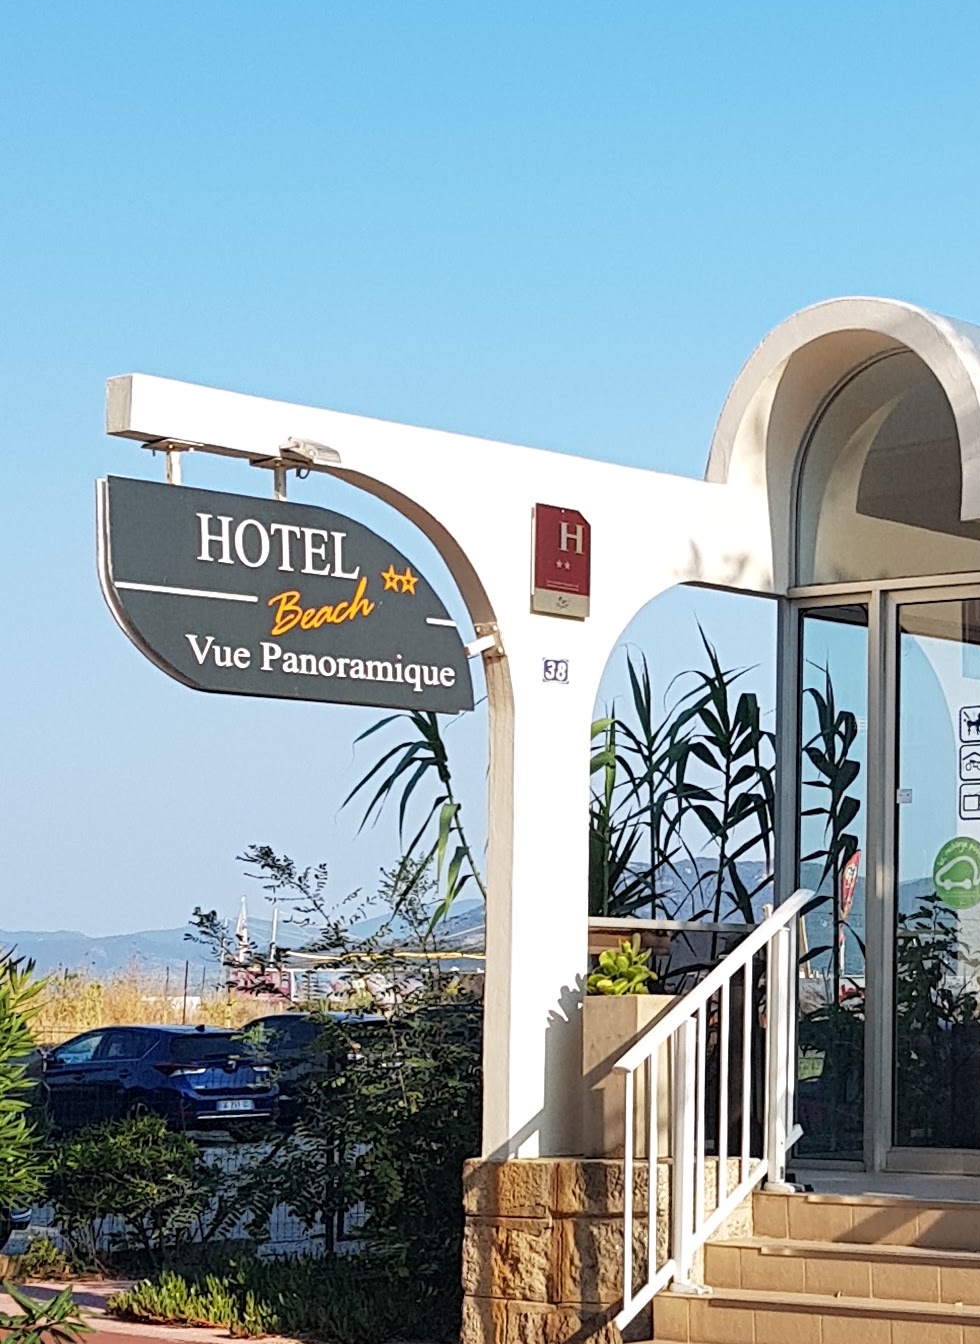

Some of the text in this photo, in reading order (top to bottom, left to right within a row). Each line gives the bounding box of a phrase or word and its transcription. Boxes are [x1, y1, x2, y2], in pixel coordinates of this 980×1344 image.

[196, 512, 361, 581] HOTEL
[559, 521, 585, 555] H
[267, 577, 375, 637] Beach
[185, 634, 456, 693] Vue Panoramique
[544, 660, 568, 681] 38
